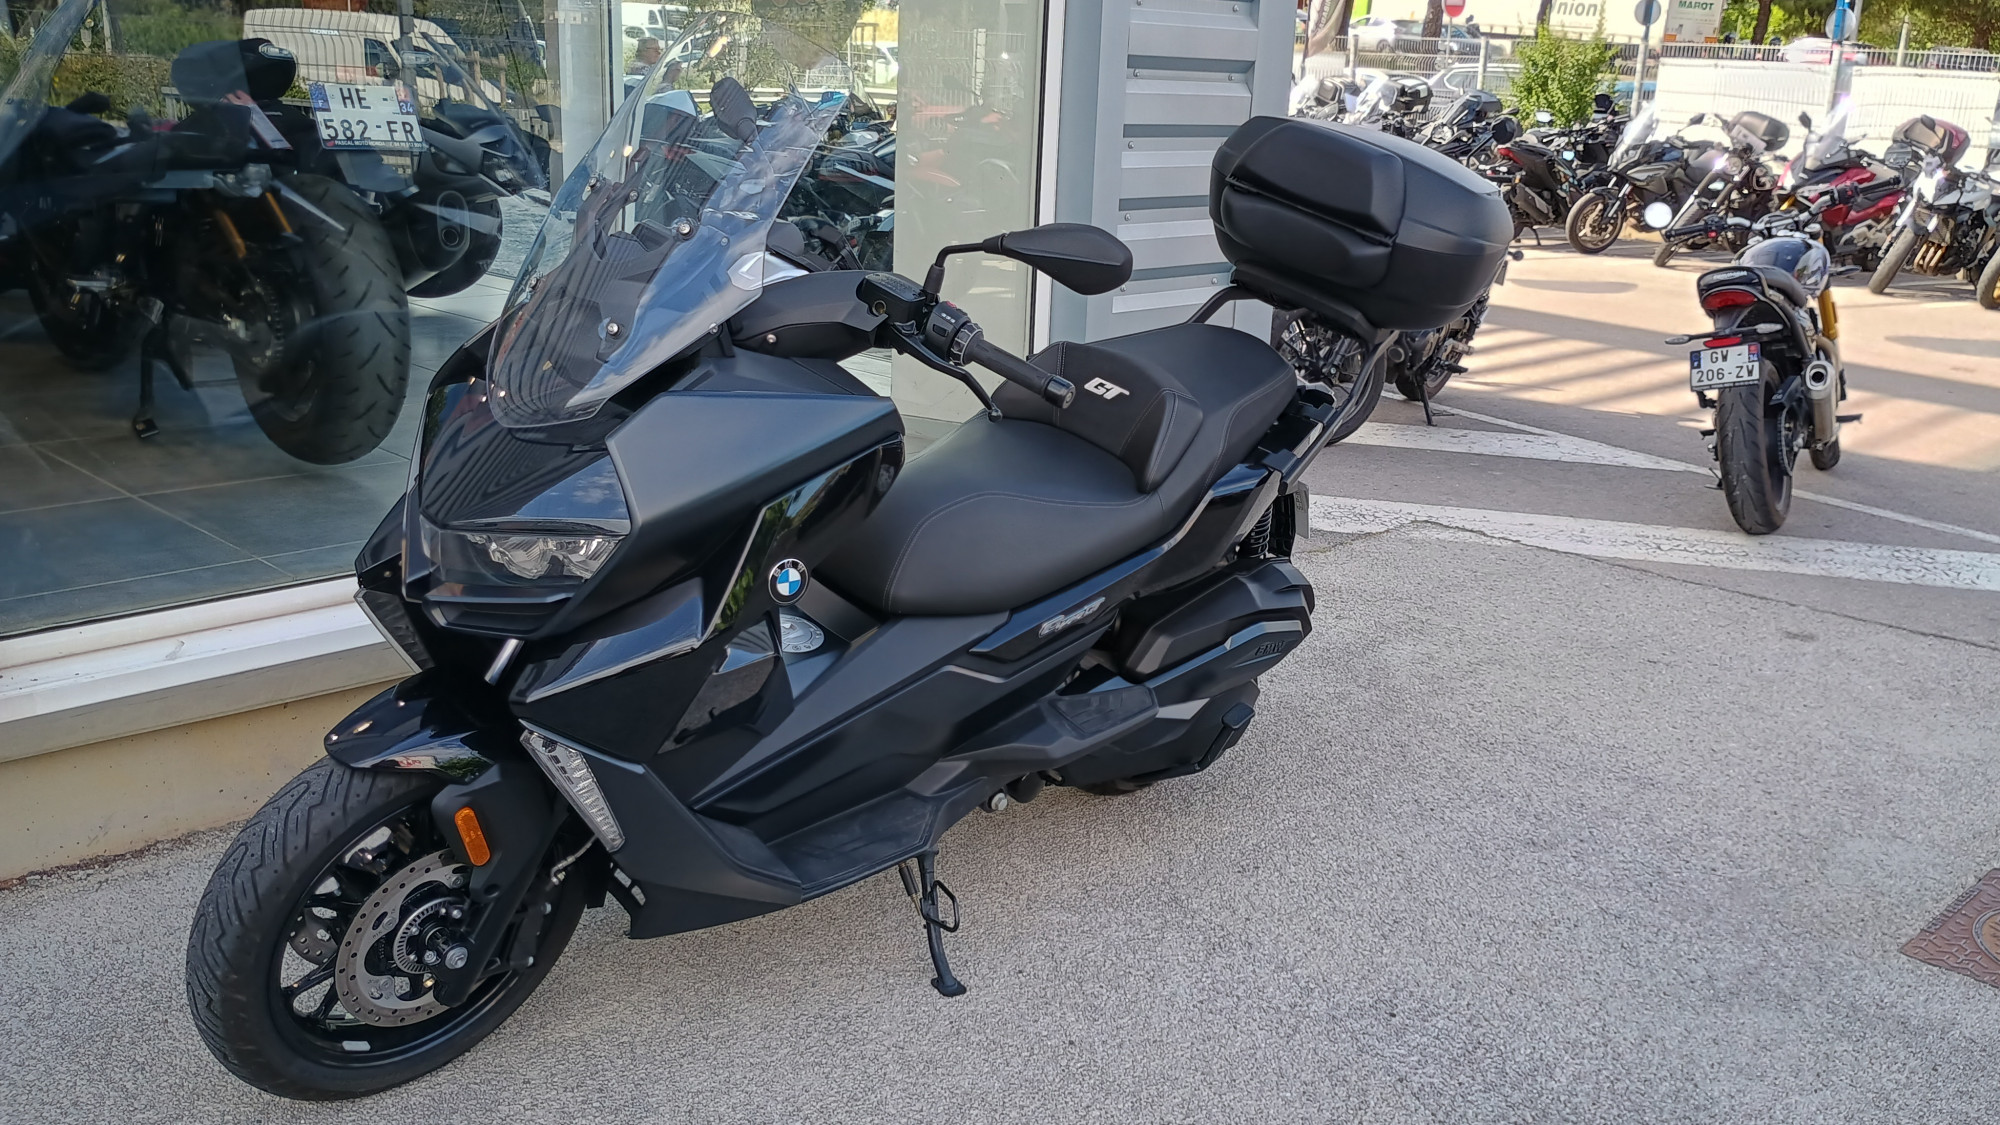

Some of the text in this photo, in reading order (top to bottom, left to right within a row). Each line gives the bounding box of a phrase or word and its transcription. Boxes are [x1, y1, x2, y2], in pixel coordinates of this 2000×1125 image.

[1678, 1, 1714, 10] MAROT
[309, 28, 340, 36] HONDA
[339, 87, 371, 110] HE
[399, 102, 414, 113] 34
[322, 118, 417, 142] 582-FR
[1710, 349, 1729, 364] GW
[1696, 364, 1755, 383] 206-ZW
[1084, 377, 1130, 400] GT
[773, 560, 806, 577] BMW
